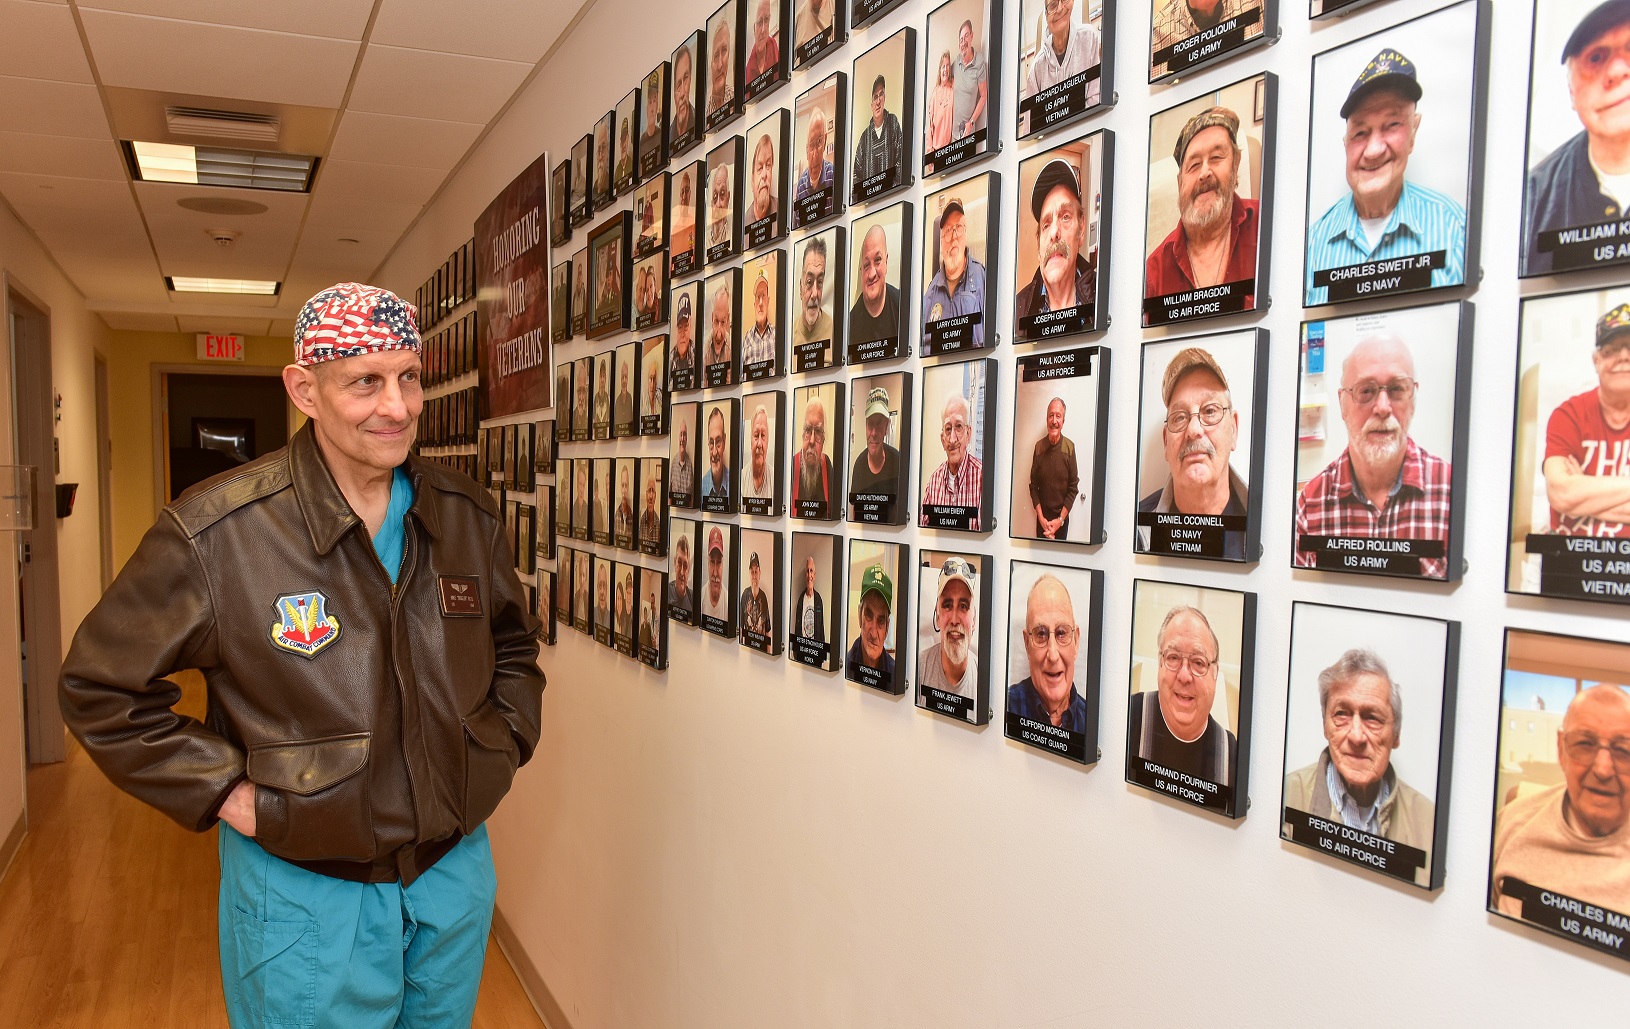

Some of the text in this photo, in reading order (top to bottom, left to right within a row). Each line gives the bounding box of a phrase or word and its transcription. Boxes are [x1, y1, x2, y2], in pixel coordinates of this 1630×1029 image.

[1173, 18, 1238, 55] ROGER POLIQUIN
[1188, 39, 1223, 62] US ARMY
[1379, 52, 1408, 67] NAVY
[1035, 72, 1087, 104] RICHARD LAGUEUX
[1045, 93, 1070, 111] US ARMY
[1045, 107, 1070, 123] VIETNAM
[934, 135, 976, 159] KENNETH WILLIAMS
[945, 151, 964, 166] US NAVY
[862, 178, 872, 188] ERIC
[493, 206, 540, 274] HONORING
[1558, 221, 1630, 245] WILLIAM K
[1594, 244, 1615, 261] US
[1329, 255, 1431, 282] CHARLES SWETT JR
[1356, 277, 1401, 294] US NAVY
[507, 277, 526, 319] OUR
[1163, 285, 1231, 306] WILLIAM BRAGDON
[1033, 308, 1077, 325] JOSEPH GOWER
[1168, 302, 1220, 319] US AIR FORCE
[936, 317, 969, 330] LARRY COLLINS
[1041, 324, 1067, 336] US ARMY
[942, 329, 961, 339] US ARMY
[206, 335, 237, 358] EXIT
[496, 326, 543, 379] VETERANS
[941, 341, 961, 351] VIETNAM
[1039, 354, 1075, 366] PAUL KOCHIS
[1037, 367, 1075, 378] US AIR FORCE
[933, 506, 966, 515] WILLIAM EMERY
[939, 518, 947, 526] US
[1157, 514, 1224, 527] DANIEL OCONNELL
[1171, 529, 1202, 540] US NAVY
[1170, 542, 1202, 553] VIETNAM
[1326, 538, 1411, 553] ALFRED ROLLINS
[1565, 538, 1616, 554] VERLIN
[1344, 556, 1389, 568] US ARMY
[1581, 559, 1603, 574] US
[278, 627, 337, 652] AIR COMBAT COMMAND
[931, 689, 963, 705] FRANK JEWETT
[936, 702, 956, 714] US ARMY
[1019, 718, 1070, 740] CLIFFORD MORGAN
[1022, 730, 1068, 752] US COAST GUARD
[1144, 761, 1219, 794] NORMAND FOURNIER
[1155, 778, 1205, 804] US AIR FORCE
[1308, 817, 1396, 854] PERCY DOUCETTE
[1319, 837, 1387, 868] US AIR FORCE
[1540, 892, 1630, 933] CHARLES MA
[1560, 916, 1624, 949] US ARMY
